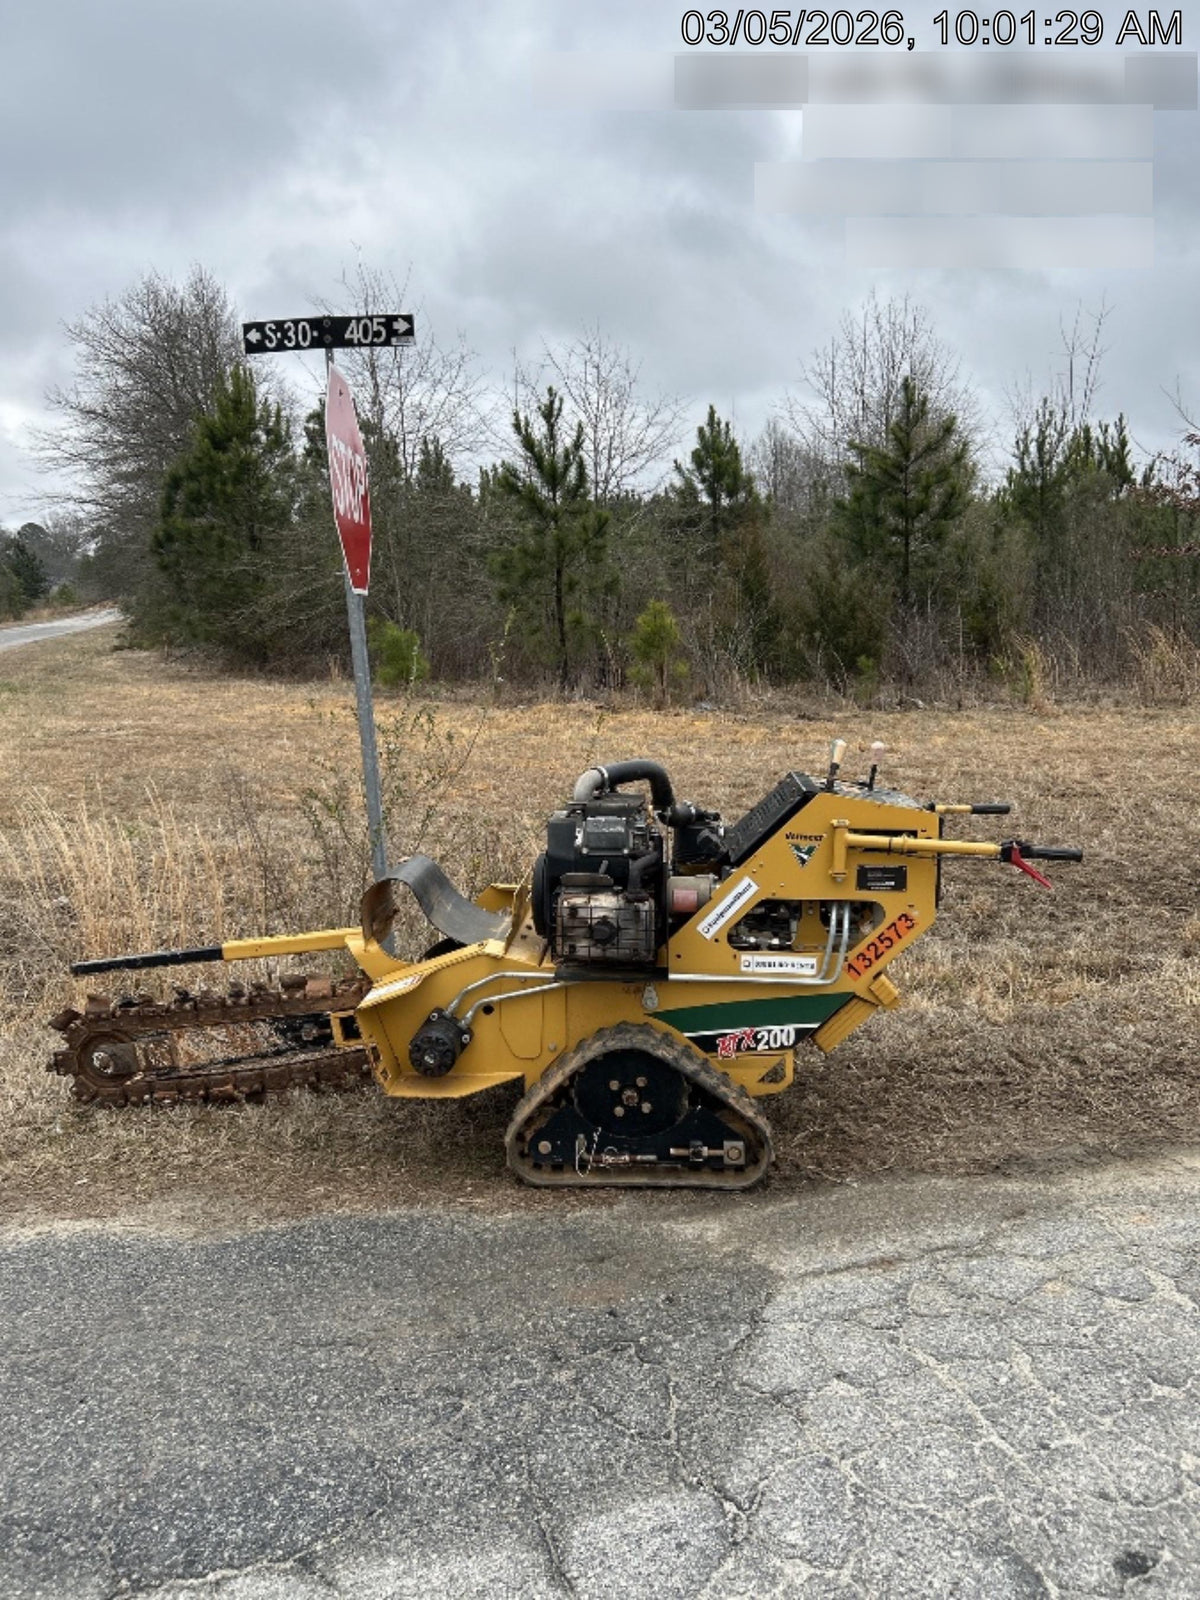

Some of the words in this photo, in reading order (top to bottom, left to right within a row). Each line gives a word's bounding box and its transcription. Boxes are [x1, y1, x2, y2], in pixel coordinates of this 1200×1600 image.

[344, 317, 387, 344] 405
[331, 433, 366, 525] STOP
[847, 912, 916, 977] 132573
